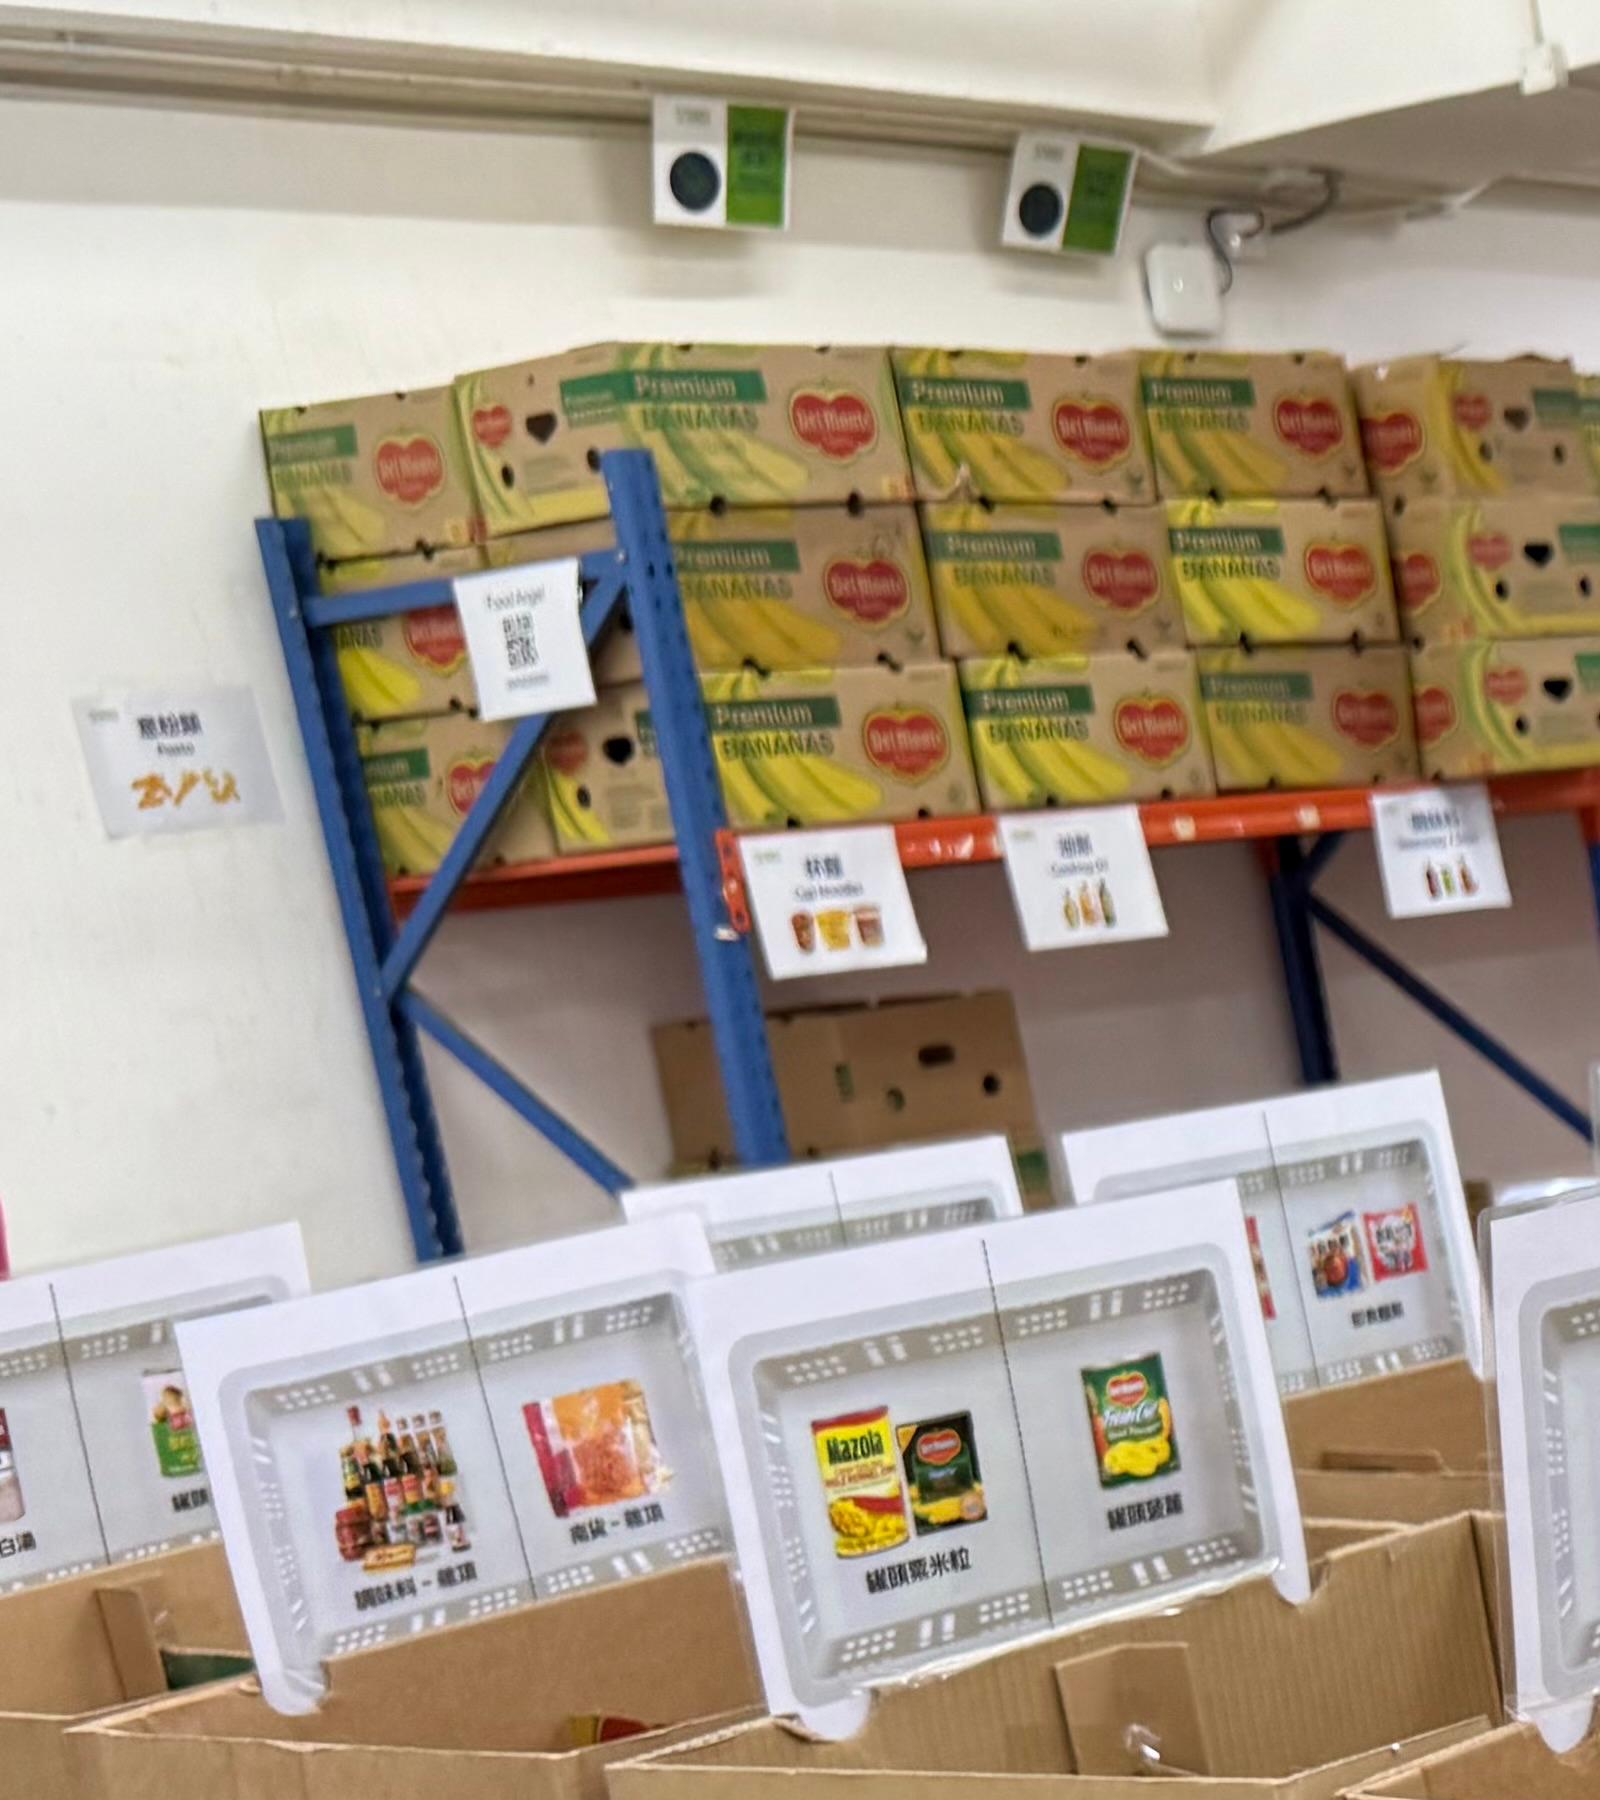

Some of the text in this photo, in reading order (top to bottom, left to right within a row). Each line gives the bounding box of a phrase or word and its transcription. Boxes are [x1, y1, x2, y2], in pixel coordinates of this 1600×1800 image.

[634, 374, 737, 398] Premium
[912, 381, 1005, 406] Premium
[1152, 380, 1233, 401] Premium
[643, 404, 758, 430] BANANAS
[916, 412, 1025, 435] BANANAS
[949, 535, 1037, 556] Premium
[1176, 530, 1262, 550] Premium
[952, 563, 1055, 587] BANANAS
[1182, 557, 1280, 581] BANANAS
[982, 690, 1069, 710] Premium
[715, 703, 813, 726] Premium
[989, 717, 1089, 742] BANANAS
[722, 731, 835, 759] BANANAS
[825, 1429, 884, 1466] Mazola
[624, 1502, 665, 1530] 雜項
[1107, 1492, 1185, 1532] 罐頭菠蘿
[866, 1546, 972, 1595] 罐頭粟米粒
[354, 1577, 417, 1611] 調味料
[437, 1561, 478, 1588] 雜項
